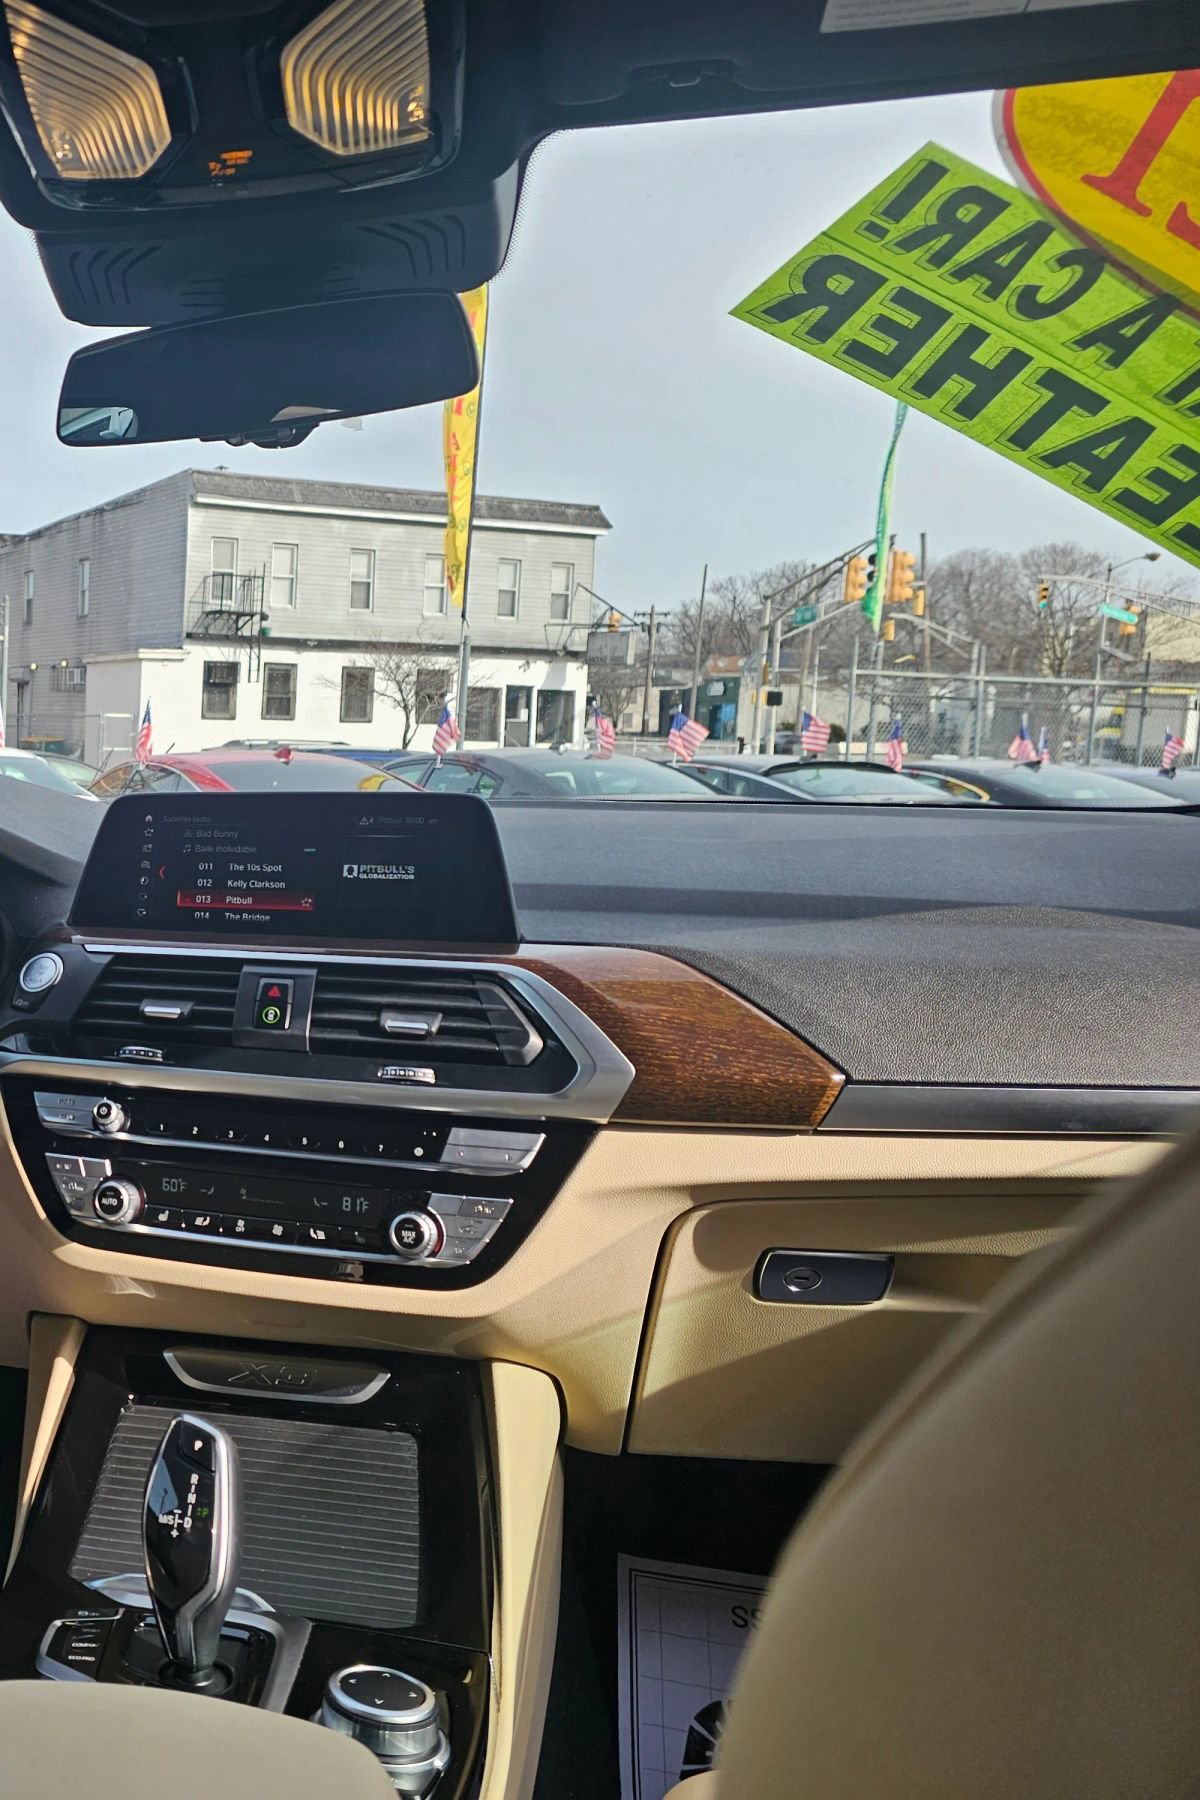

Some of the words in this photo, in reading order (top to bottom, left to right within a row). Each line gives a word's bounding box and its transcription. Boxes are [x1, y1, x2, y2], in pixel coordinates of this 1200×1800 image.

[196, 830, 212, 838] Bad
[213, 830, 239, 840] Bunny
[198, 862, 213, 871] 011
[229, 863, 244, 871] The
[247, 863, 260, 871] 10s
[262, 863, 282, 873] Spot
[359, 865, 415, 874] PITBULL'S
[197, 879, 212, 887] 012
[227, 879, 247, 889] Kelly
[249, 879, 285, 889] Clarkson
[196, 895, 211, 904] 013
[225, 895, 253, 905] Pitbull
[225, 912, 241, 920] The
[242, 912, 271, 921] Bridge
[192, 1126, 199, 1135] 2
[228, 1130, 234, 1139] 3
[263, 1133, 270, 1142] 4
[338, 1140, 345, 1149] 6
[101, 1197, 118, 1206] AUTO
[401, 1229, 416, 1238] MAX
[402, 1236, 415, 1244] A/C
[194, 1440, 203, 1451] P
[190, 1473, 199, 1485] R
[187, 1493, 196, 1504] N
[183, 1516, 192, 1528] D
